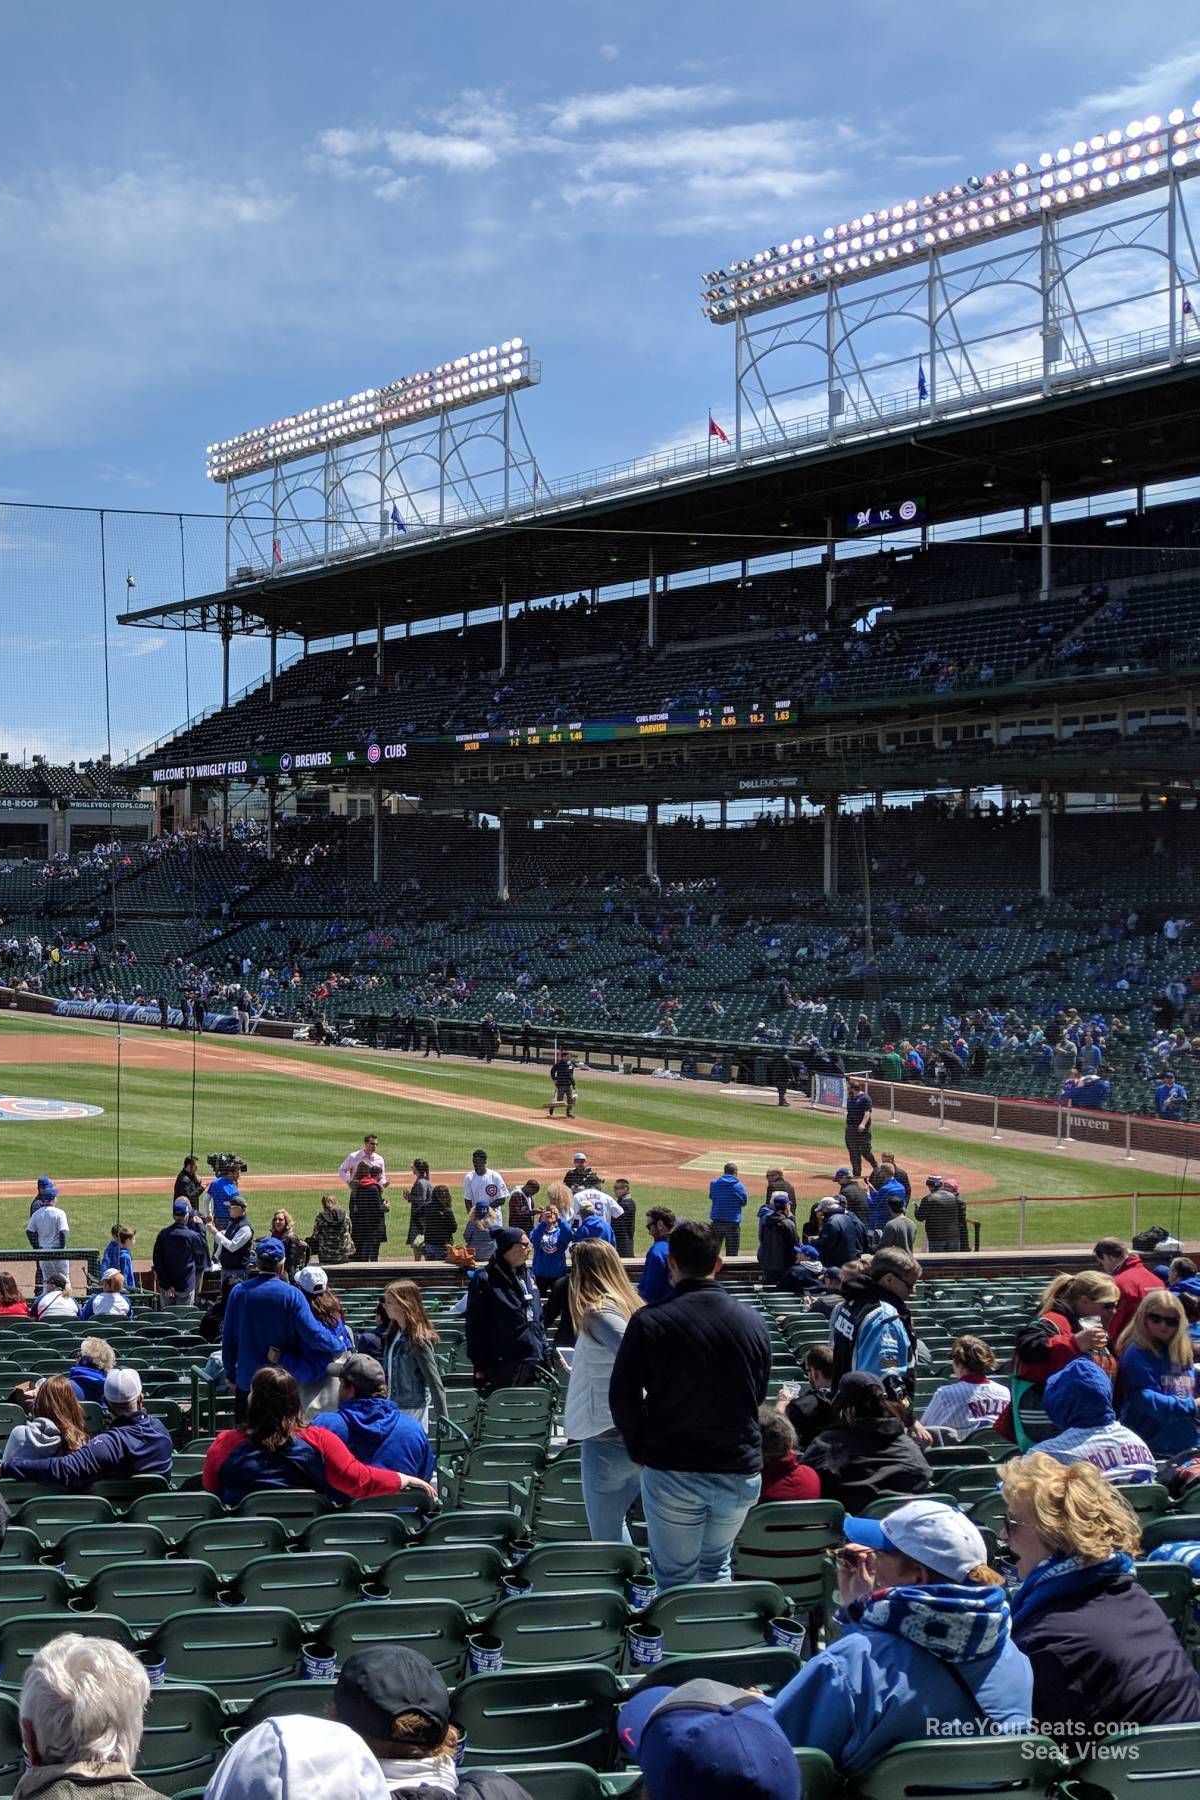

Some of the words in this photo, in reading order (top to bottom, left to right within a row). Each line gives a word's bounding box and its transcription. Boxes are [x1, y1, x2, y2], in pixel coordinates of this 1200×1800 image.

[776, 700, 791, 709] WHIP
[723, 706, 734, 714] ERA
[750, 714, 764, 723] 19.2
[774, 711, 789, 720] 1.63
[700, 719, 712, 728] 0-2
[721, 717, 736, 726] 6.86
[640, 723, 667, 734] DARVISH
[385, 744, 407, 758] CUBS
[295, 752, 331, 768] BREWERS
[153, 768, 184, 782] WELCOME
[186, 767, 195, 779] TO
[197, 764, 226, 777] WRIGLEY
[228, 762, 247, 775] FIELD
[56, 1001, 93, 1017] Reynolds
[92, 1003, 114, 1019] Wrap
